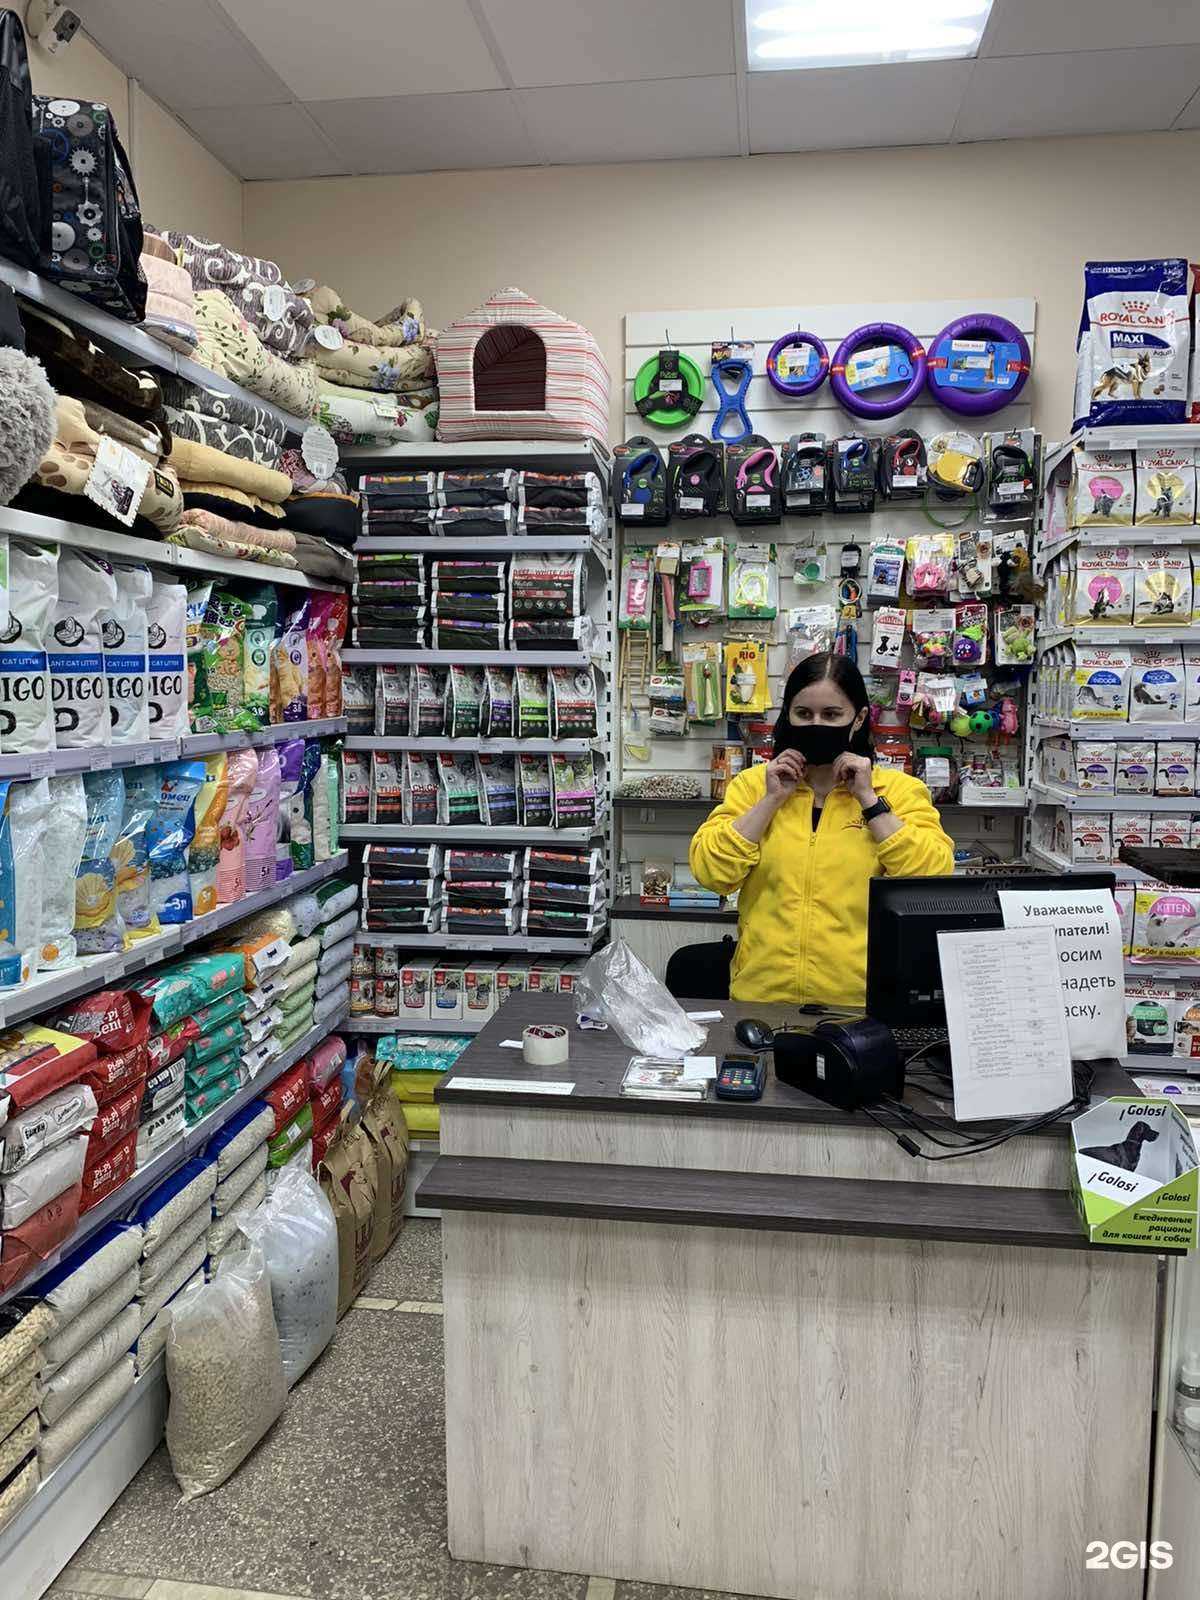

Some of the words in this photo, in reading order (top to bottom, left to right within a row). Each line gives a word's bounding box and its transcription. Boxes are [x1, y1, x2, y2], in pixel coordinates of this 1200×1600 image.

[1100, 313, 1136, 324] ROYAL
[1138, 315, 1175, 325] CAN
[1112, 332, 1145, 344] MAXI
[739, 651, 756, 660] RIO
[148, 675, 183, 696] IGO
[1023, 904, 1105, 917] Уважаемые
[1157, 903, 1191, 913] KITTEN
[1055, 922, 1110, 937] патели!
[1057, 949, 1103, 962] осим
[101, 1106, 119, 1127] Pi-Pi
[94, 1160, 111, 1179] Pi-Pi
[1133, 1213, 1193, 1225] Ежедневные
[1102, 1229, 1120, 1239] для
[1121, 1232, 1152, 1241] кошек
[1163, 1233, 1191, 1244] собак
[1148, 1225, 1193, 1235] рационы
